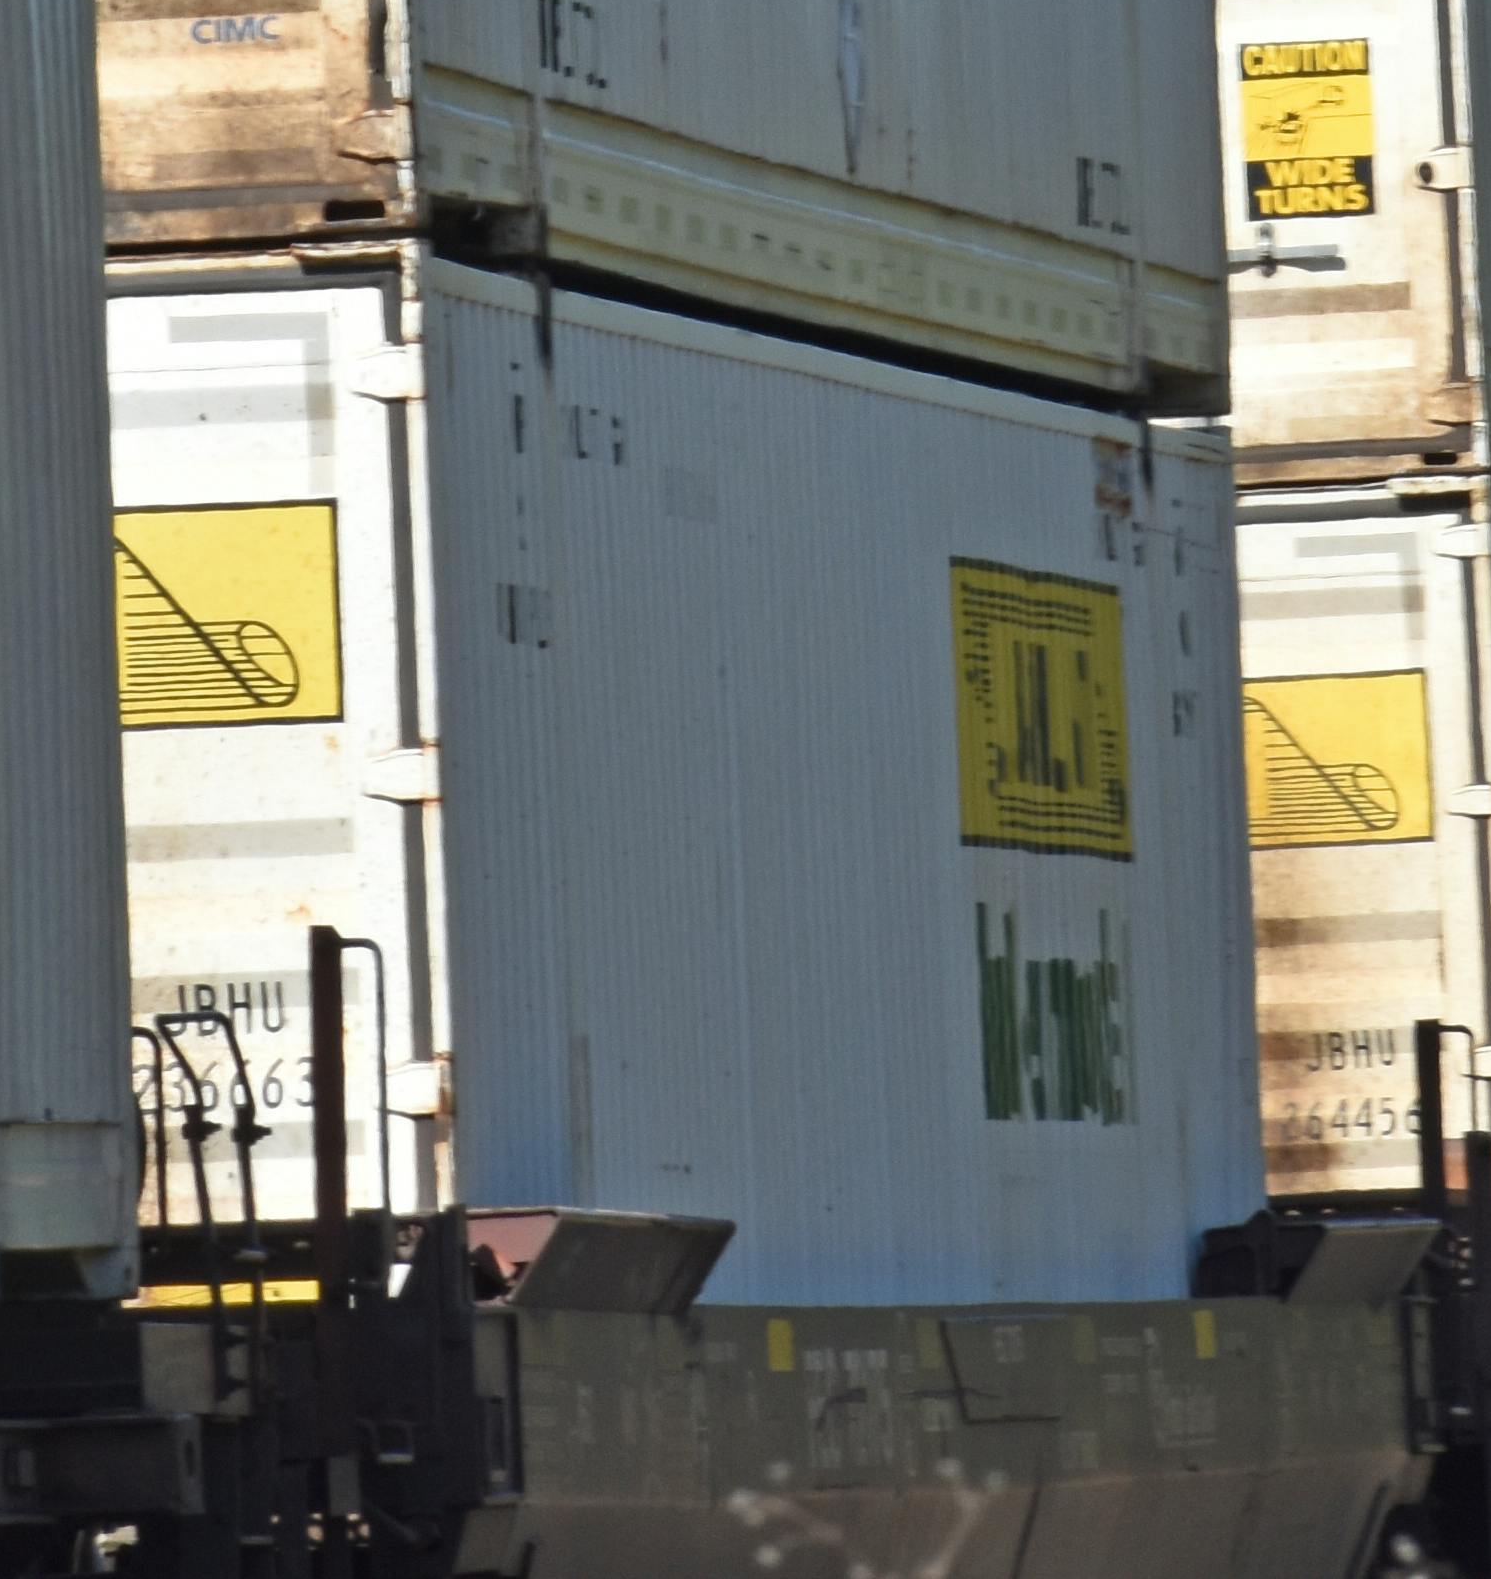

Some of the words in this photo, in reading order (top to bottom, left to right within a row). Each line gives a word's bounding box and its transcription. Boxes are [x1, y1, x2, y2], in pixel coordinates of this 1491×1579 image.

[190, 15, 281, 45] CIMC
[1242, 40, 1367, 76] CAUTION
[1264, 158, 1356, 187] WIDE
[1253, 184, 1370, 215] TURNS
[164, 981, 285, 1037] JBHU
[1307, 1028, 1396, 1072] JBHU
